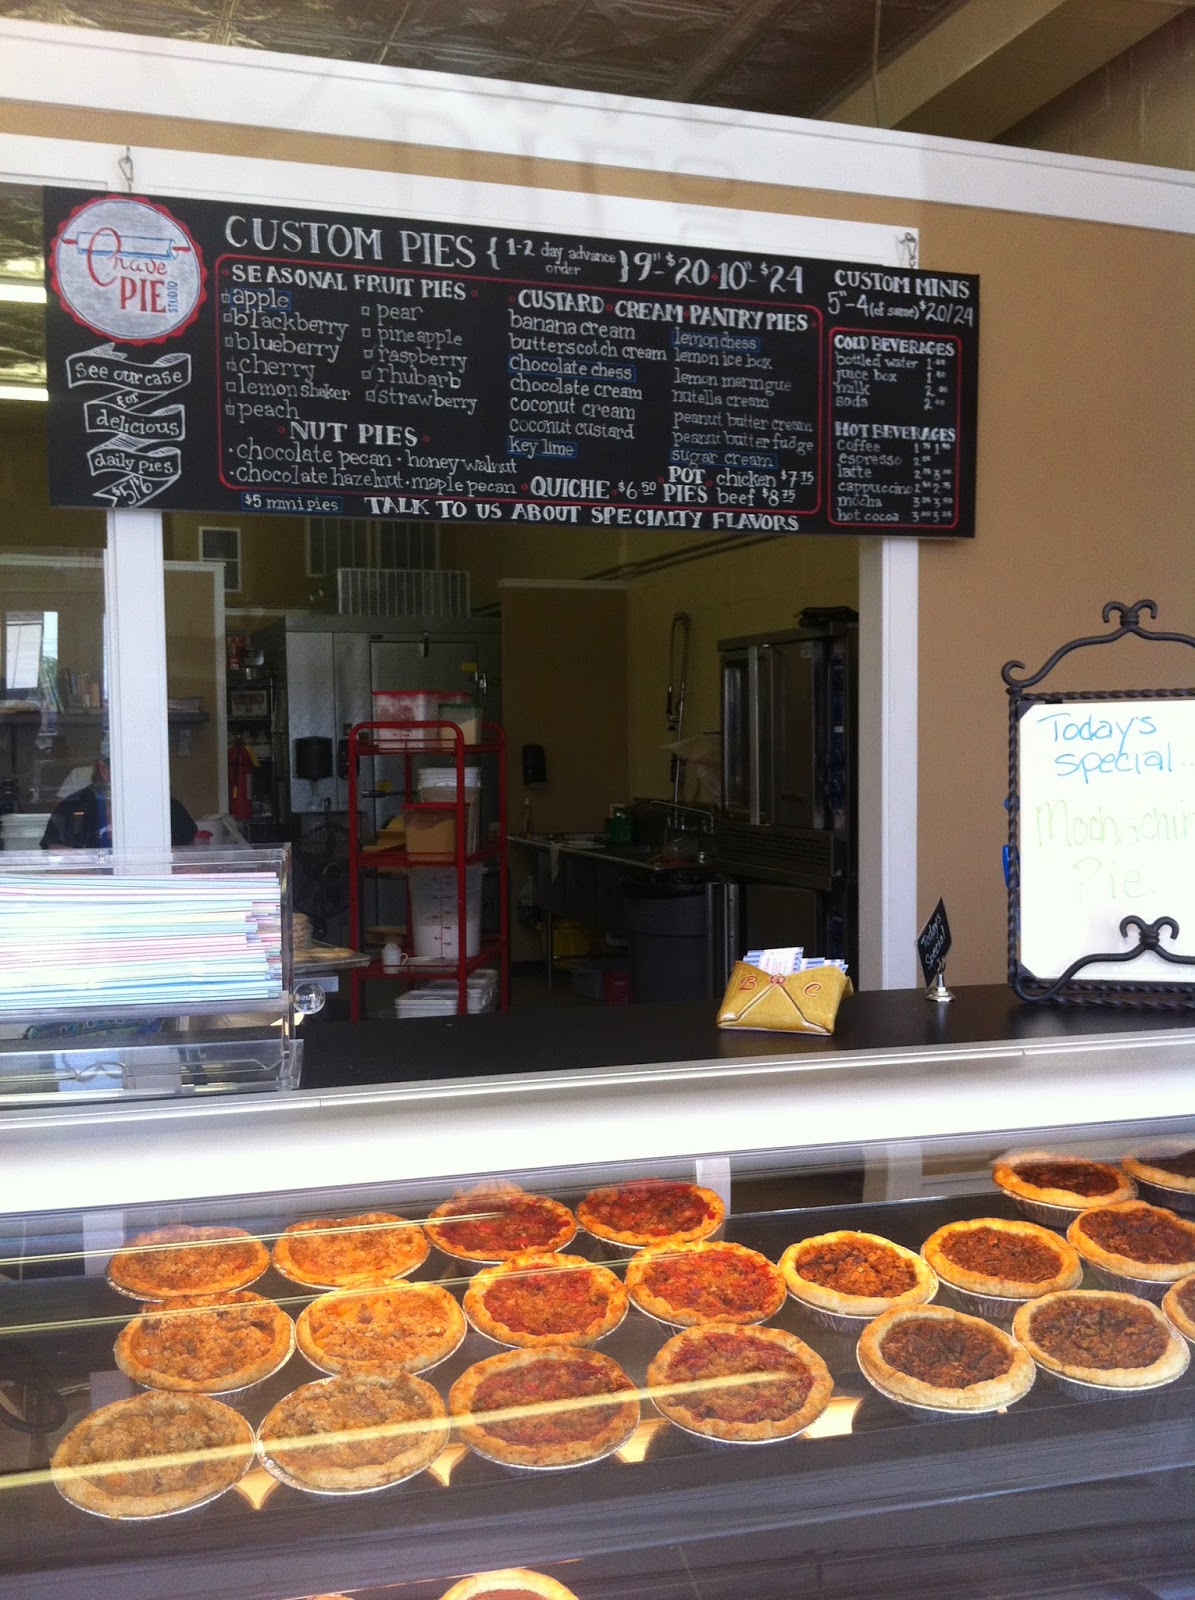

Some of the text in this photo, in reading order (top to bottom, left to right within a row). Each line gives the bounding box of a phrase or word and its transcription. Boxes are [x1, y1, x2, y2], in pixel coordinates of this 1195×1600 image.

[224, 215, 383, 260] CUSTOM
[399, 230, 477, 268] PIES
[506, 238, 535, 256] 1-2
[540, 241, 564, 265] day
[568, 245, 617, 263] advance
[87, 227, 167, 287] Crave
[545, 261, 581, 275] order
[120, 276, 167, 313] PIE
[232, 264, 467, 301] SEASONAL FRUIT PIES
[834, 269, 970, 299] CUSTOM MINIS
[167, 280, 179, 313] STUDIO
[232, 287, 290, 313] apple
[376, 304, 424, 326] pear
[518, 289, 808, 332] CUSTARD CREAM PANTRY PIES
[920, 299, 974, 328] $20/24
[233, 309, 349, 341] blackberry
[508, 309, 636, 340] banana cream
[235, 332, 339, 363] blueberry
[378, 326, 463, 350] pineapple
[508, 333, 667, 361] butterscotch cream
[674, 327, 757, 350] lemon chess
[834, 334, 955, 357] COLD BEVERAGES
[239, 353, 315, 383] cherry
[377, 347, 468, 373] raspberry
[509, 353, 632, 380] chocolate chess
[674, 347, 773, 369] lemon ice box
[835, 351, 882, 367] bottled
[885, 357, 919, 369] water
[114, 370, 143, 385] our
[145, 371, 183, 386] case
[238, 374, 351, 401] lemon shaker
[376, 364, 461, 389] rhubarb
[510, 373, 643, 400] chocolate cream
[674, 367, 792, 397] lemon meringue
[874, 368, 898, 382] box
[116, 392, 139, 408] for
[671, 389, 770, 409] nutella cream
[833, 380, 871, 396] milk
[238, 399, 300, 424] peach
[378, 388, 478, 415] strawberry
[510, 396, 636, 420] coconut cream
[96, 409, 180, 436] delicious
[289, 420, 418, 447] NUT PIES
[509, 418, 635, 440] coconut custard
[673, 411, 813, 432] peanut butter cream
[834, 421, 956, 442] HOT BEVERAGES
[509, 435, 574, 459] key lime
[672, 430, 814, 456] peanut butter fudge
[94, 453, 173, 474] daily pies
[236, 437, 518, 475] chocolate pecan honey walnut
[671, 449, 774, 469] sugar cream
[839, 452, 902, 466] espresso
[236, 462, 518, 497] chocolate hazelnut maple pecan
[668, 466, 706, 484] POT
[716, 467, 777, 487] chicken
[837, 464, 872, 478] latte
[530, 476, 610, 499] QUICHE
[663, 483, 709, 504] PIES
[716, 487, 756, 507] beef
[838, 481, 914, 496] cappuccino
[244, 494, 339, 513] $5 mini pies
[364, 496, 800, 531] TALK TO US ABOUT SPECIALTY FLAVORS
[837, 495, 883, 507] mocha
[836, 508, 862, 521] hot
[864, 513, 900, 521] cocoa
[1037, 713, 1157, 754] Today's
